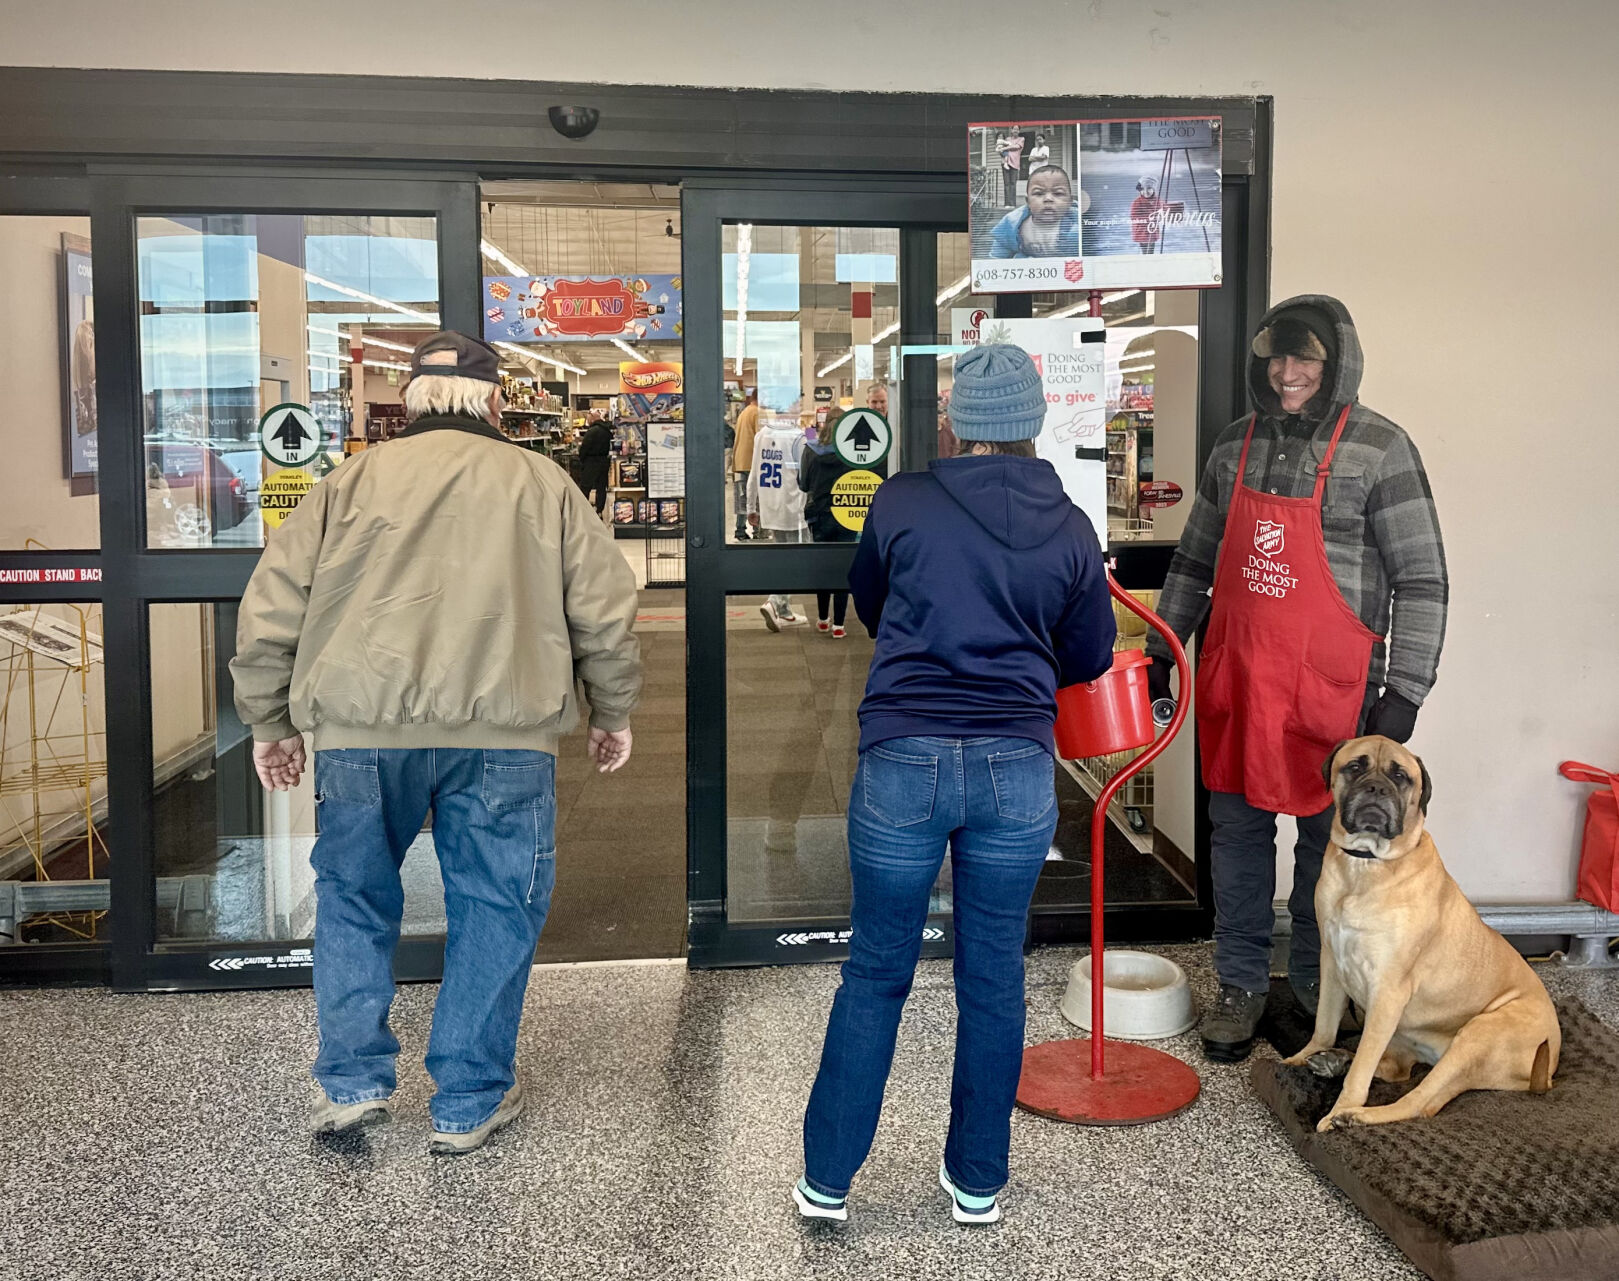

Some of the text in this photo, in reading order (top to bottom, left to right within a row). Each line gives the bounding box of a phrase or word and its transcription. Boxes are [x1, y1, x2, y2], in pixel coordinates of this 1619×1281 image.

[1158, 126, 1196, 138] GOOD
[976, 267, 1058, 280] 608-757-8300
[552, 297, 624, 316] TOYLAND
[1048, 353, 1086, 364] DOING
[1047, 364, 1068, 373] THE
[1071, 363, 1101, 373] MOST
[1047, 374, 1082, 384] GOOD
[1045, 389, 1096, 406] to give
[286, 452, 298, 461] IN
[856, 453, 867, 462] IN
[760, 462, 782, 488] 25
[263, 482, 318, 492] AUTOMATI
[835, 483, 881, 491] AUTOMAT
[1263, 537, 1280, 550] ARMY
[1248, 554, 1290, 575] DOING
[0, 569, 40, 582] CAUTION
[44, 568, 75, 581] STAND
[1241, 567, 1299, 589] THE MOST
[1248, 581, 1287, 598] GOOD
